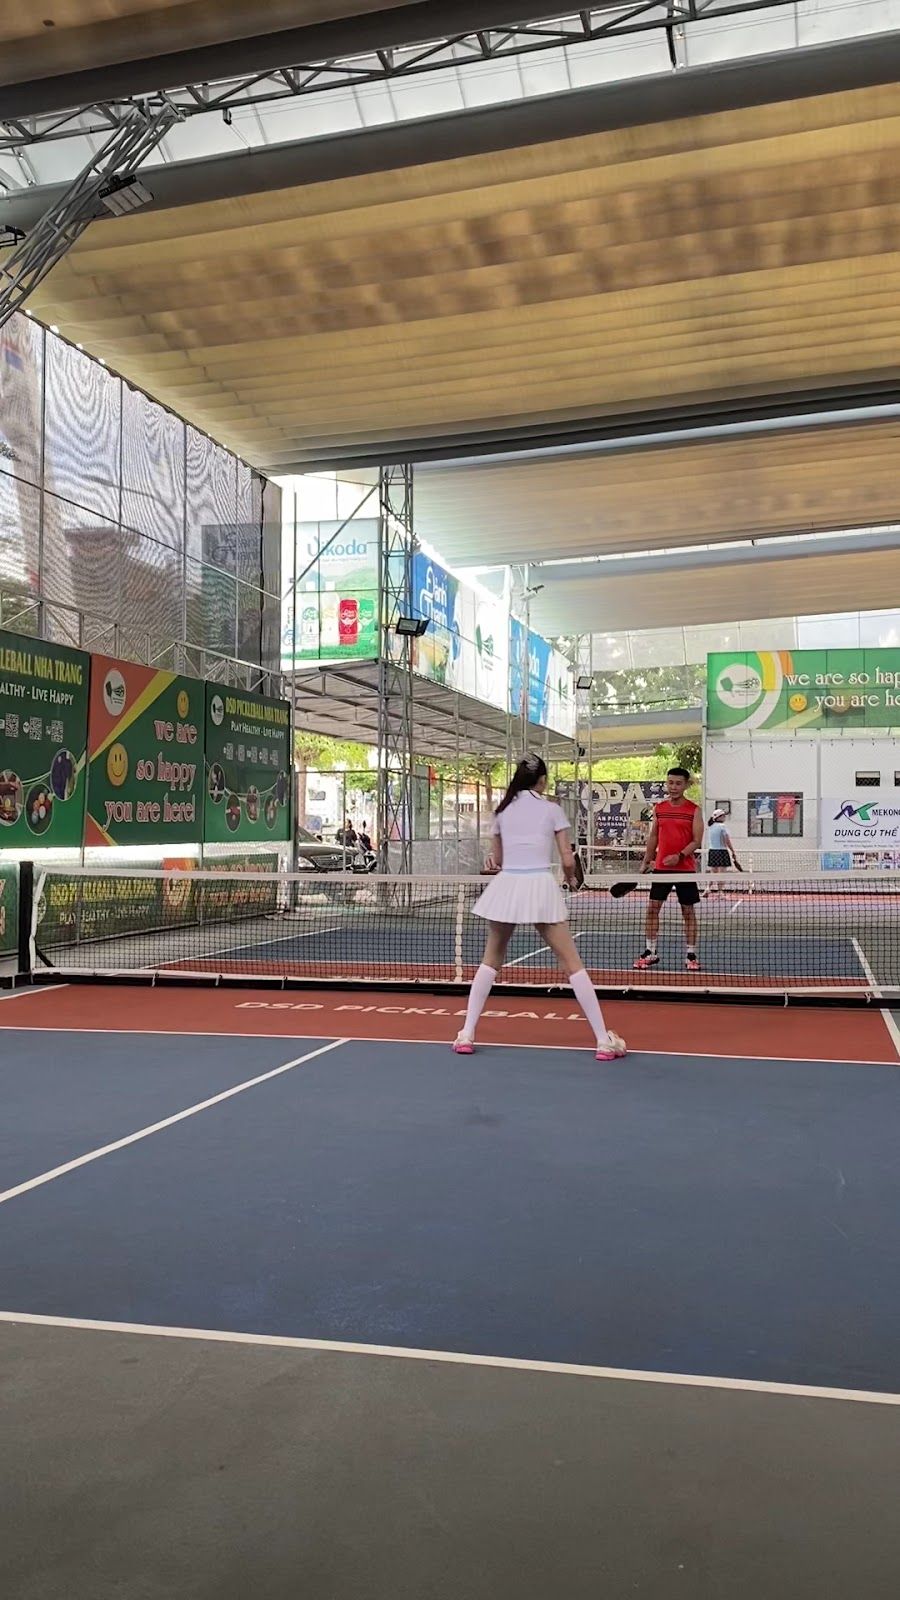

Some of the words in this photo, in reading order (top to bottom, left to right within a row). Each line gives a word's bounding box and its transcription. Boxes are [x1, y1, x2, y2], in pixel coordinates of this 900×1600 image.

[34, 655, 53, 679] NHA
[54, 660, 82, 686] TRANG
[784, 673, 810, 686] we
[815, 672, 844, 685] are
[848, 672, 870, 684] so
[813, 694, 845, 712] you
[850, 694, 880, 707] are
[153, 720, 175, 742] we
[176, 722, 198, 744] are
[136, 759, 155, 781] so
[157, 751, 197, 792] happy
[102, 800, 133, 833] you
[136, 800, 161, 823] are
[234, 1002, 324, 1010] DSD
